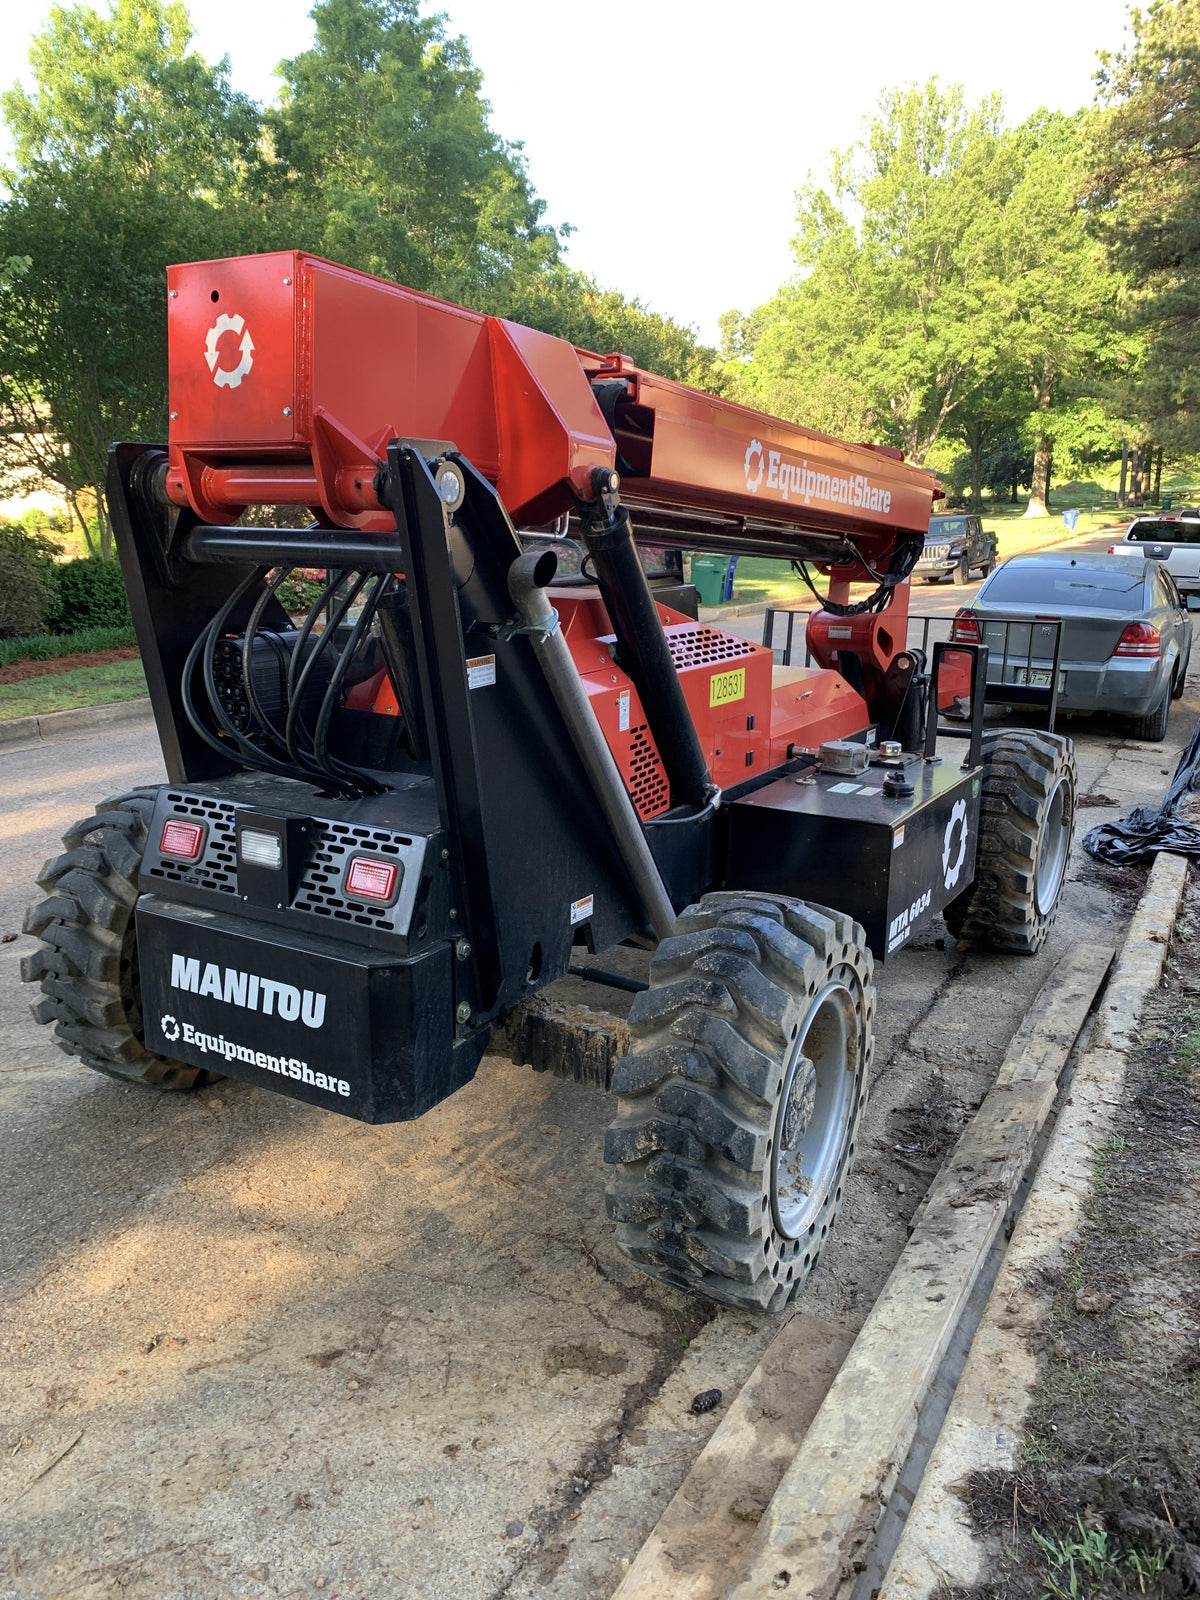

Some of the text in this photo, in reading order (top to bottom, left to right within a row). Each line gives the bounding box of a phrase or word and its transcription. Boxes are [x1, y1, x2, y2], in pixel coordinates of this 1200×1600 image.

[766, 450, 891, 513] EquipmentShare
[712, 673, 742, 701] 128531
[888, 908, 909, 941] MTA
[909, 888, 931, 922] 6034
[170, 953, 327, 1029] MANITOU
[182, 1022, 351, 1097] EquipmentShare
